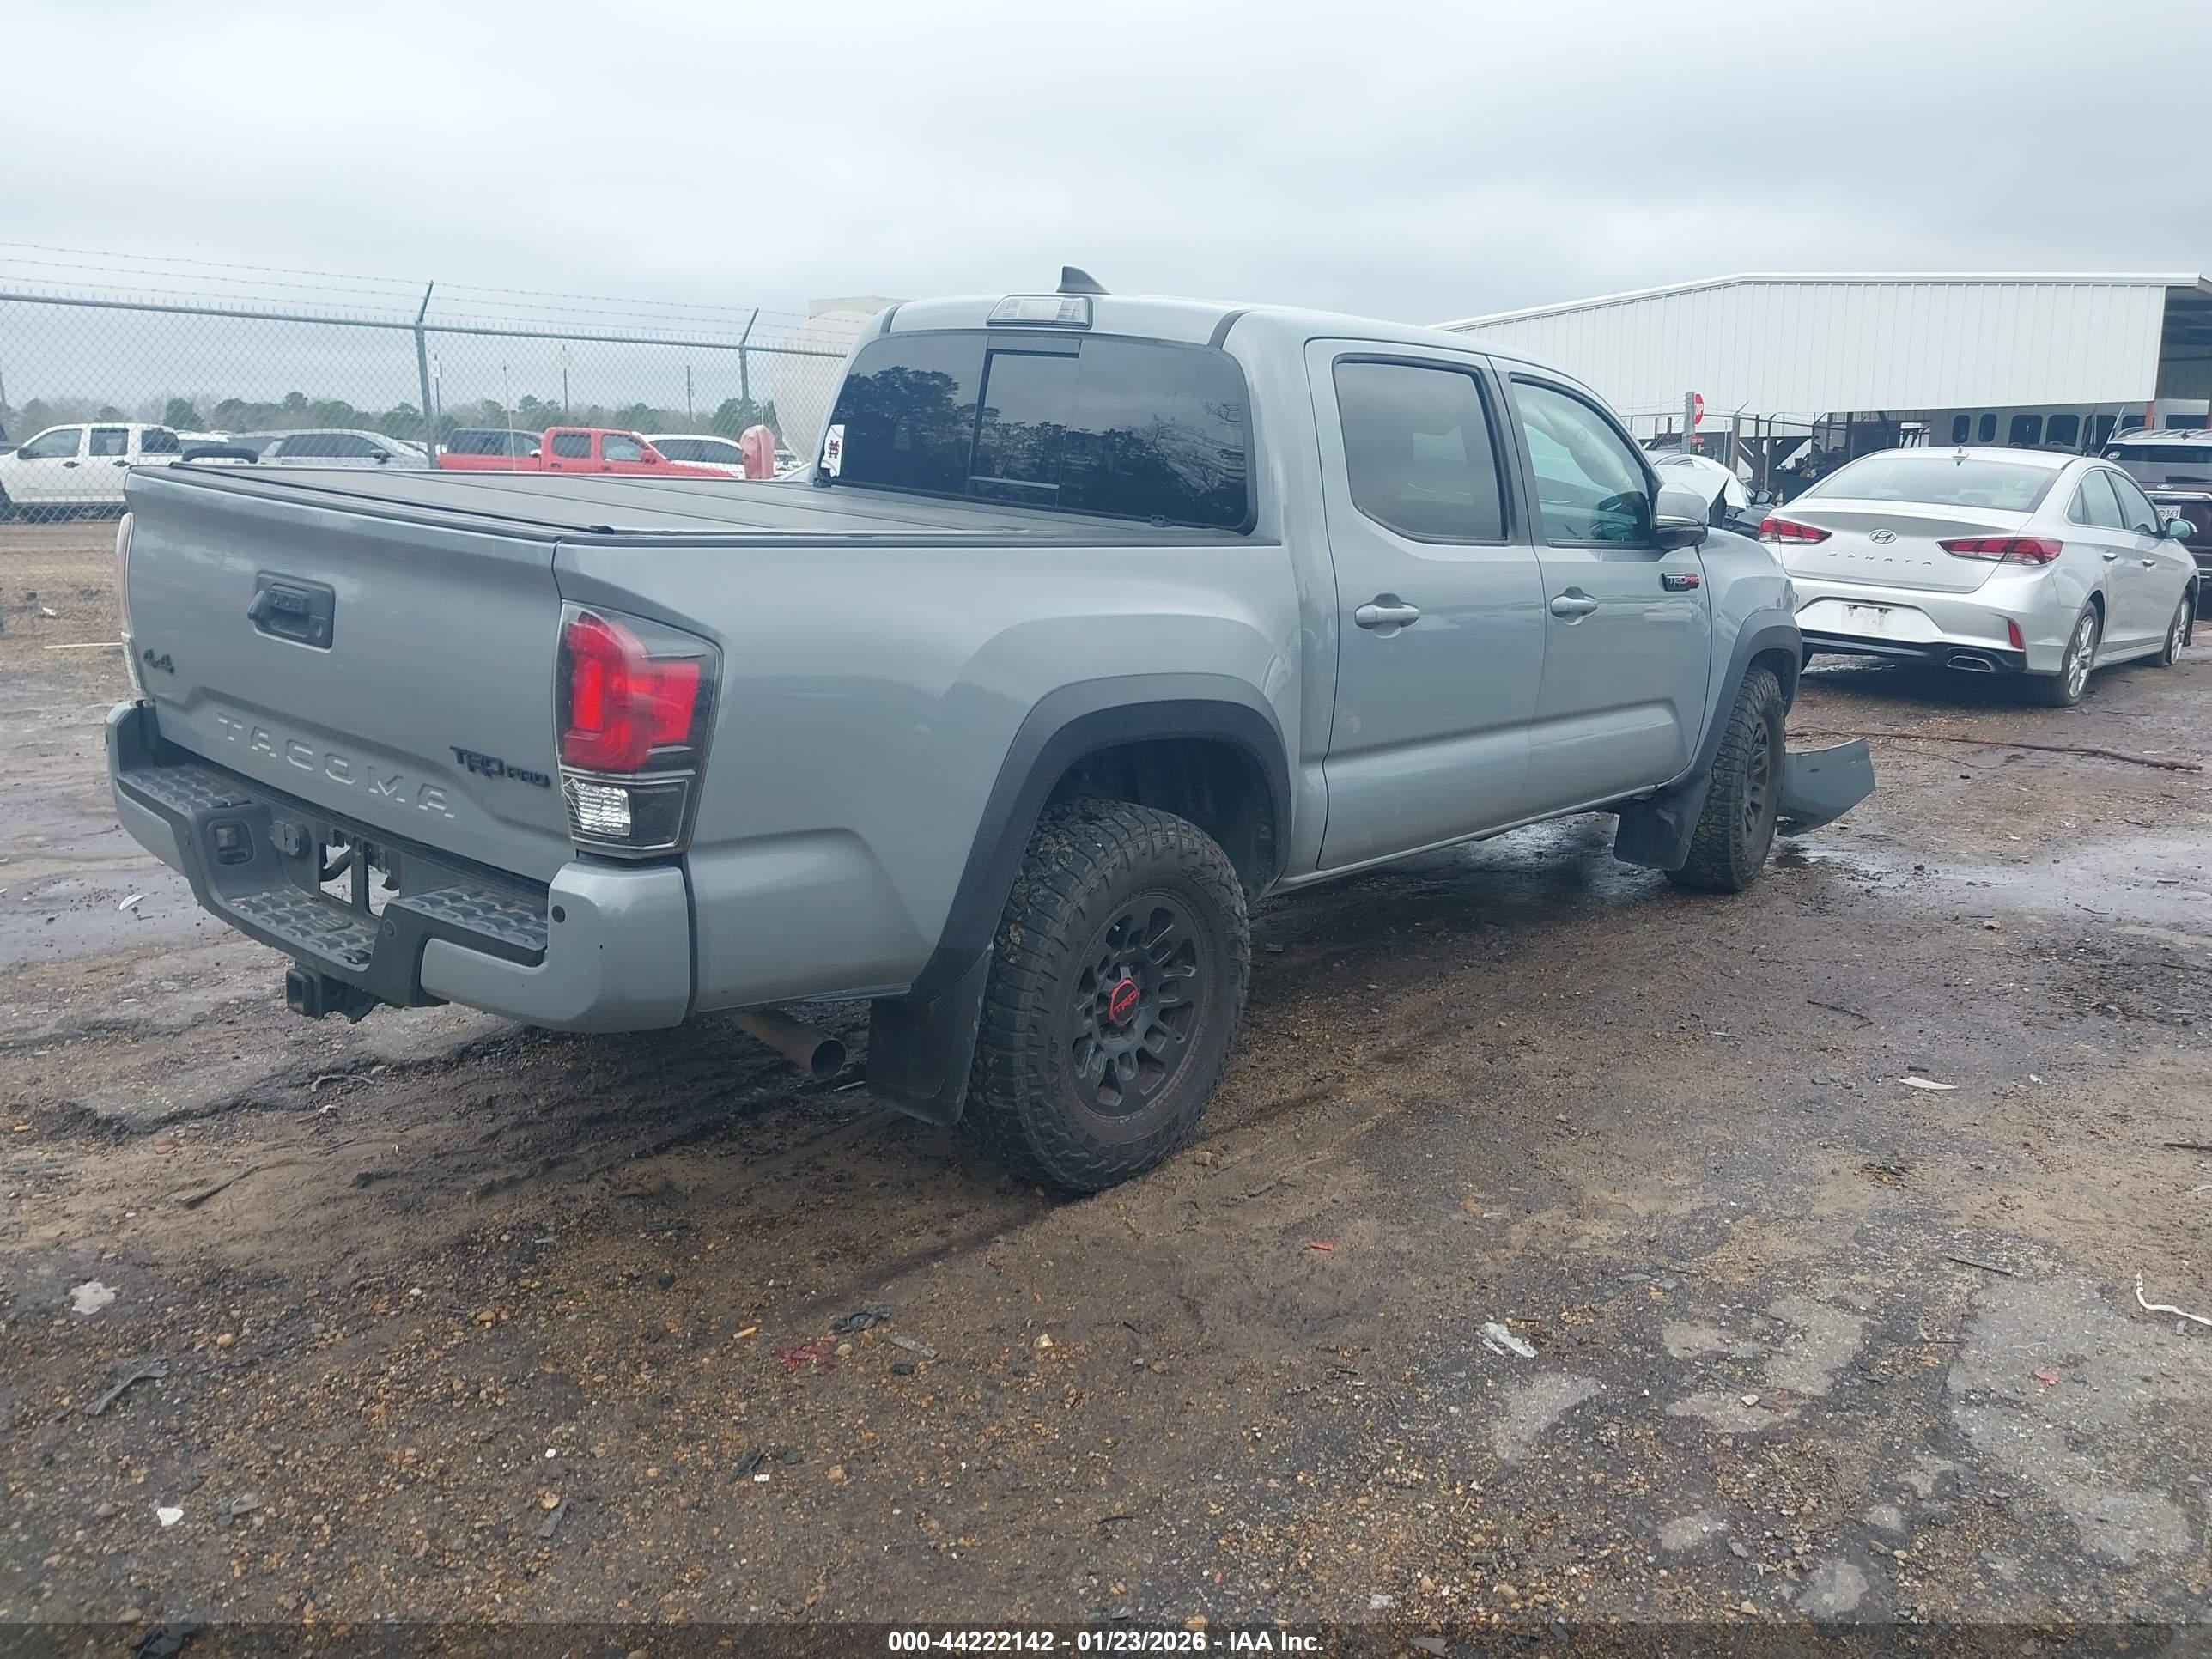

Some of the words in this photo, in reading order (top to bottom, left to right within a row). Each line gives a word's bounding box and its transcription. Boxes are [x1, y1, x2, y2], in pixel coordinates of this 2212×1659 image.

[1827, 551, 1933, 566] SONATA
[216, 712, 456, 819] TACOMA
[448, 744, 505, 778] TRD
[1113, 989, 1138, 1013] TRD
